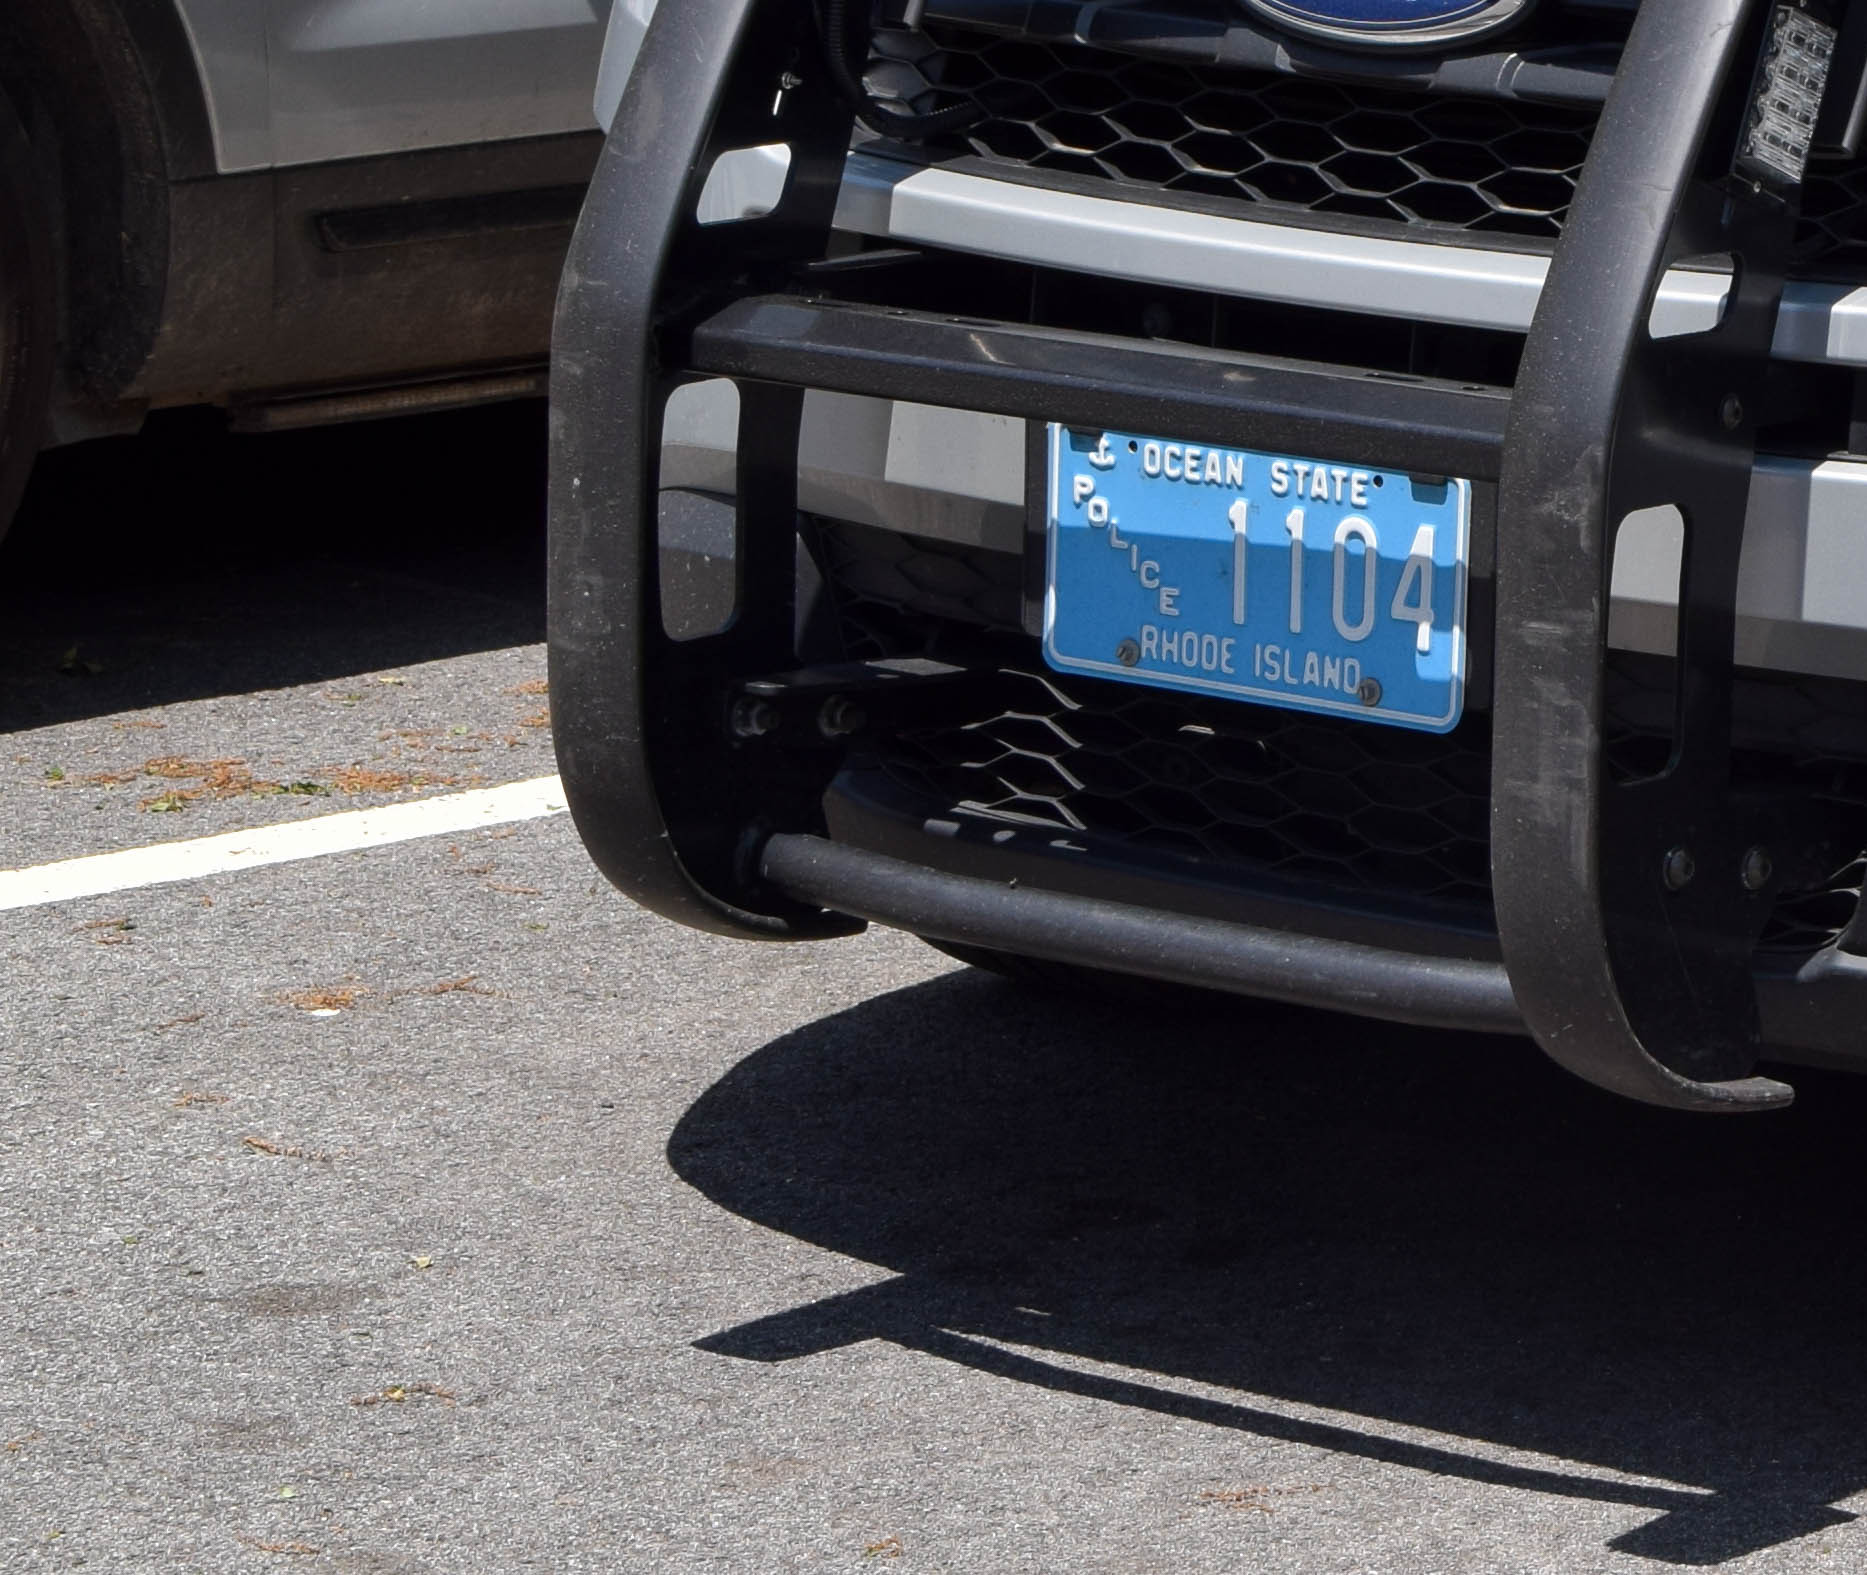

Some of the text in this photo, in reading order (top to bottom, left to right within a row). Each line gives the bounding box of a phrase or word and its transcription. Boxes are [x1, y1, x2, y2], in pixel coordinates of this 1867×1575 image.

[1143, 442, 1369, 507] OCEAN STATE
[1072, 474, 1180, 616] POLICE
[1228, 497, 1436, 653] 1104
[1141, 624, 1361, 694] RHODE ISLAND
